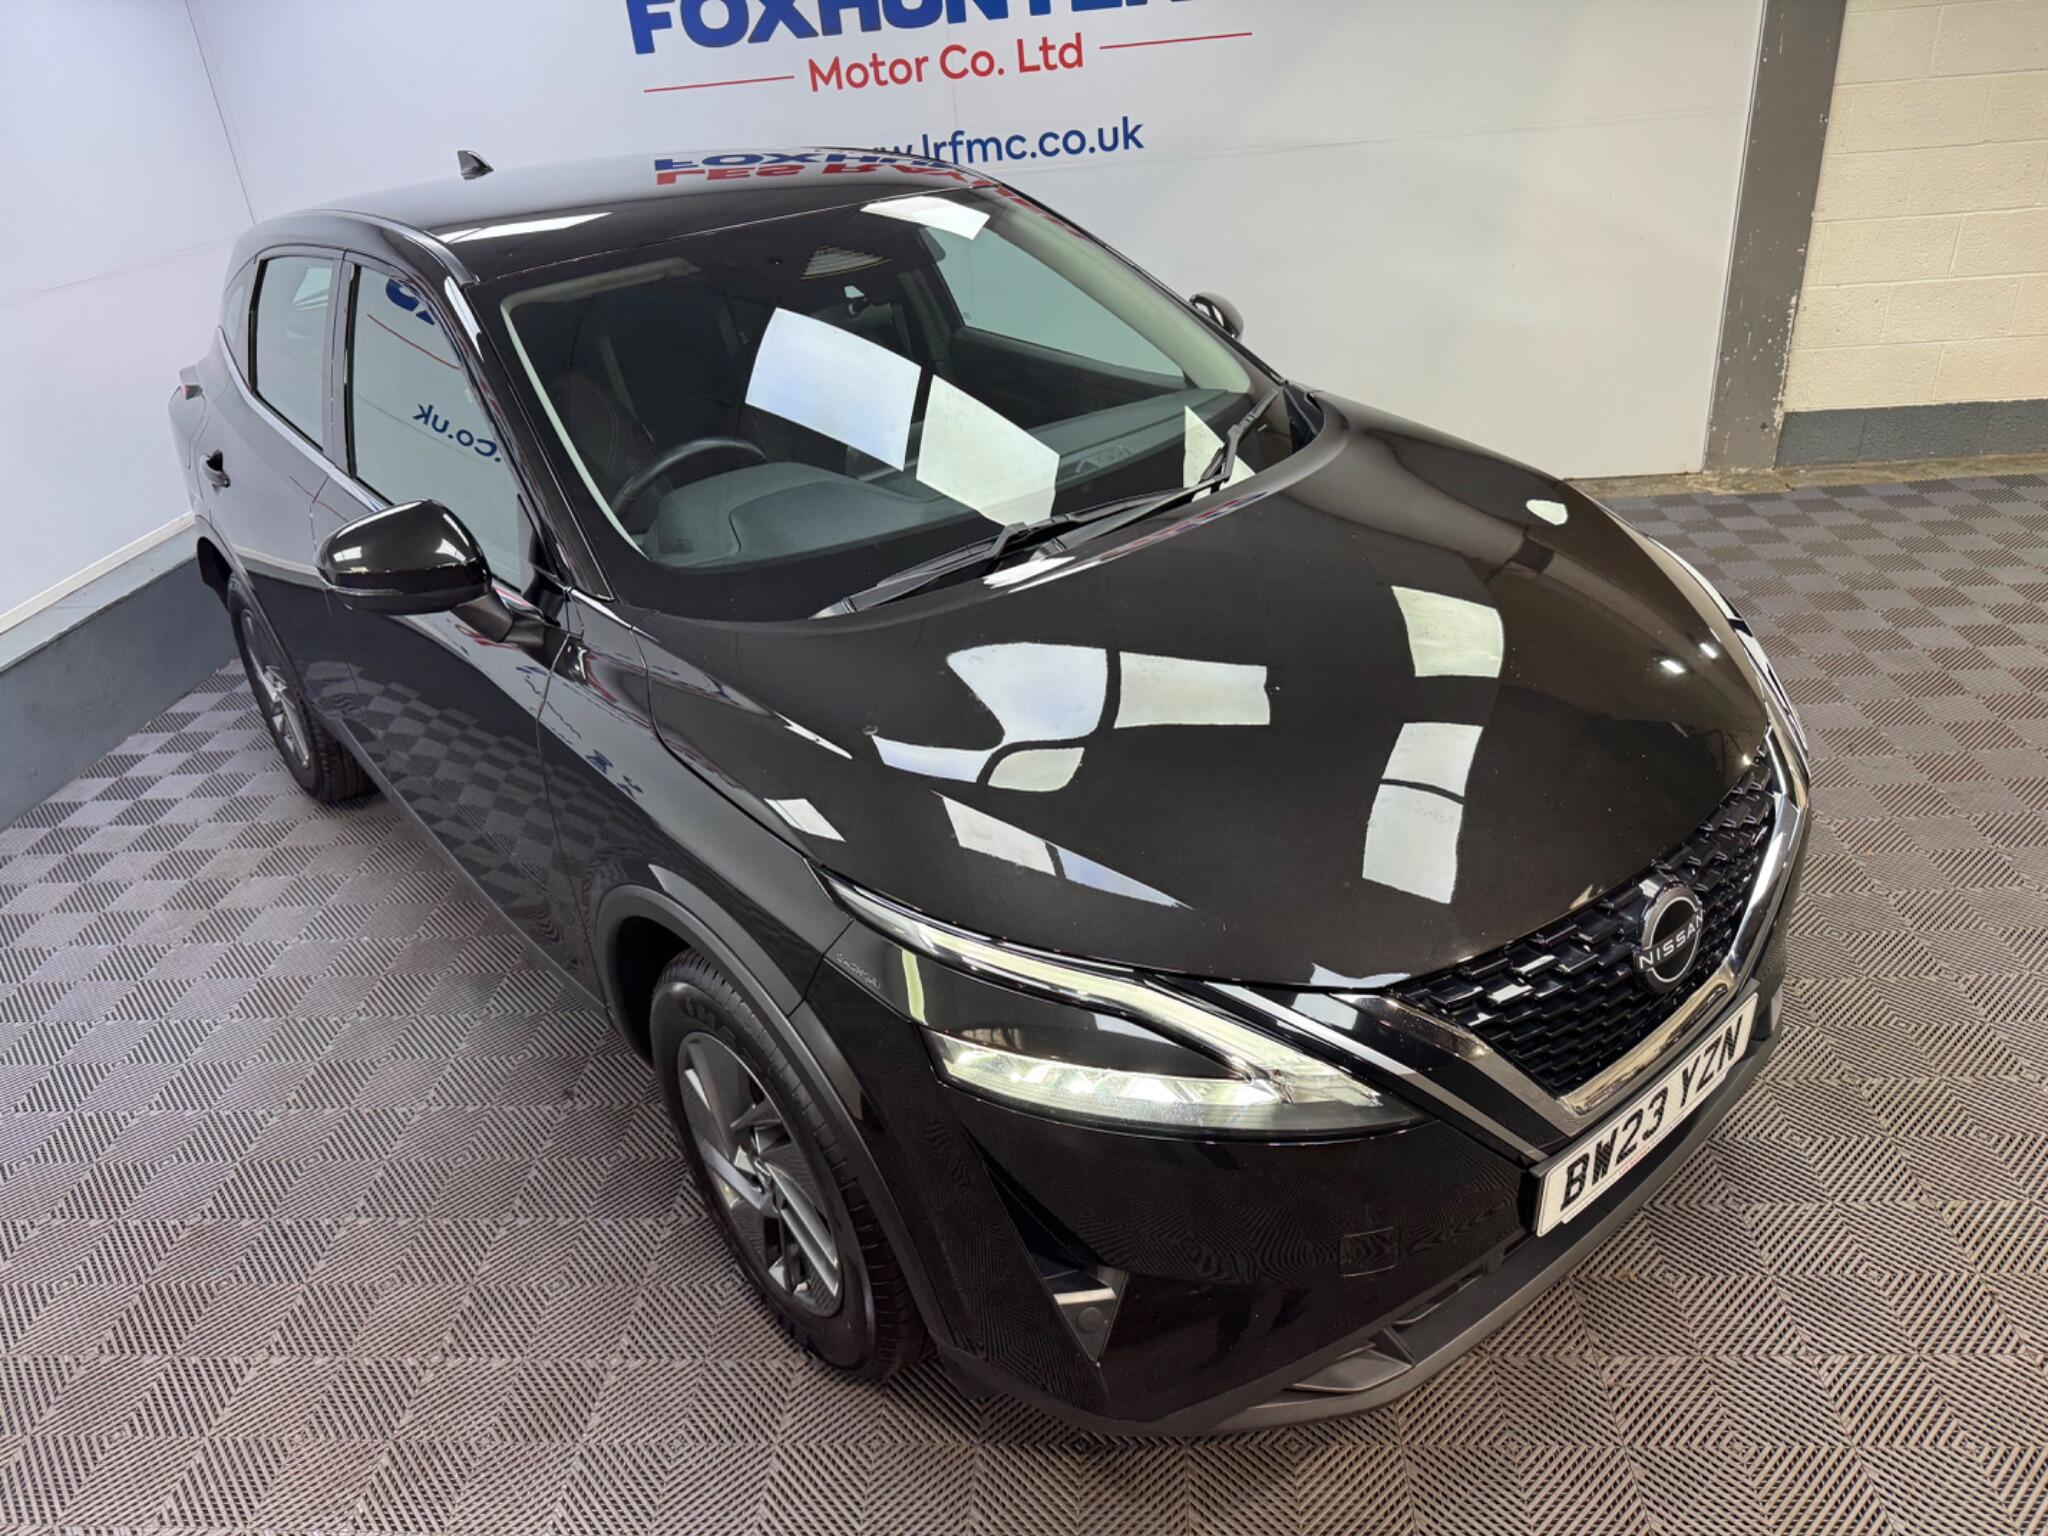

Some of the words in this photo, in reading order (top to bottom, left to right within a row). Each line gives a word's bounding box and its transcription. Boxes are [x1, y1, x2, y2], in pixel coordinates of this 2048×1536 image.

[808, 52, 929, 92] Motor
[939, 44, 1004, 79] Co.
[1017, 32, 1084, 73] Ltd
[1638, 908, 1704, 970] NISSAN
[1560, 1086, 1669, 1212] BW23
[1681, 1014, 1743, 1108] YZN
